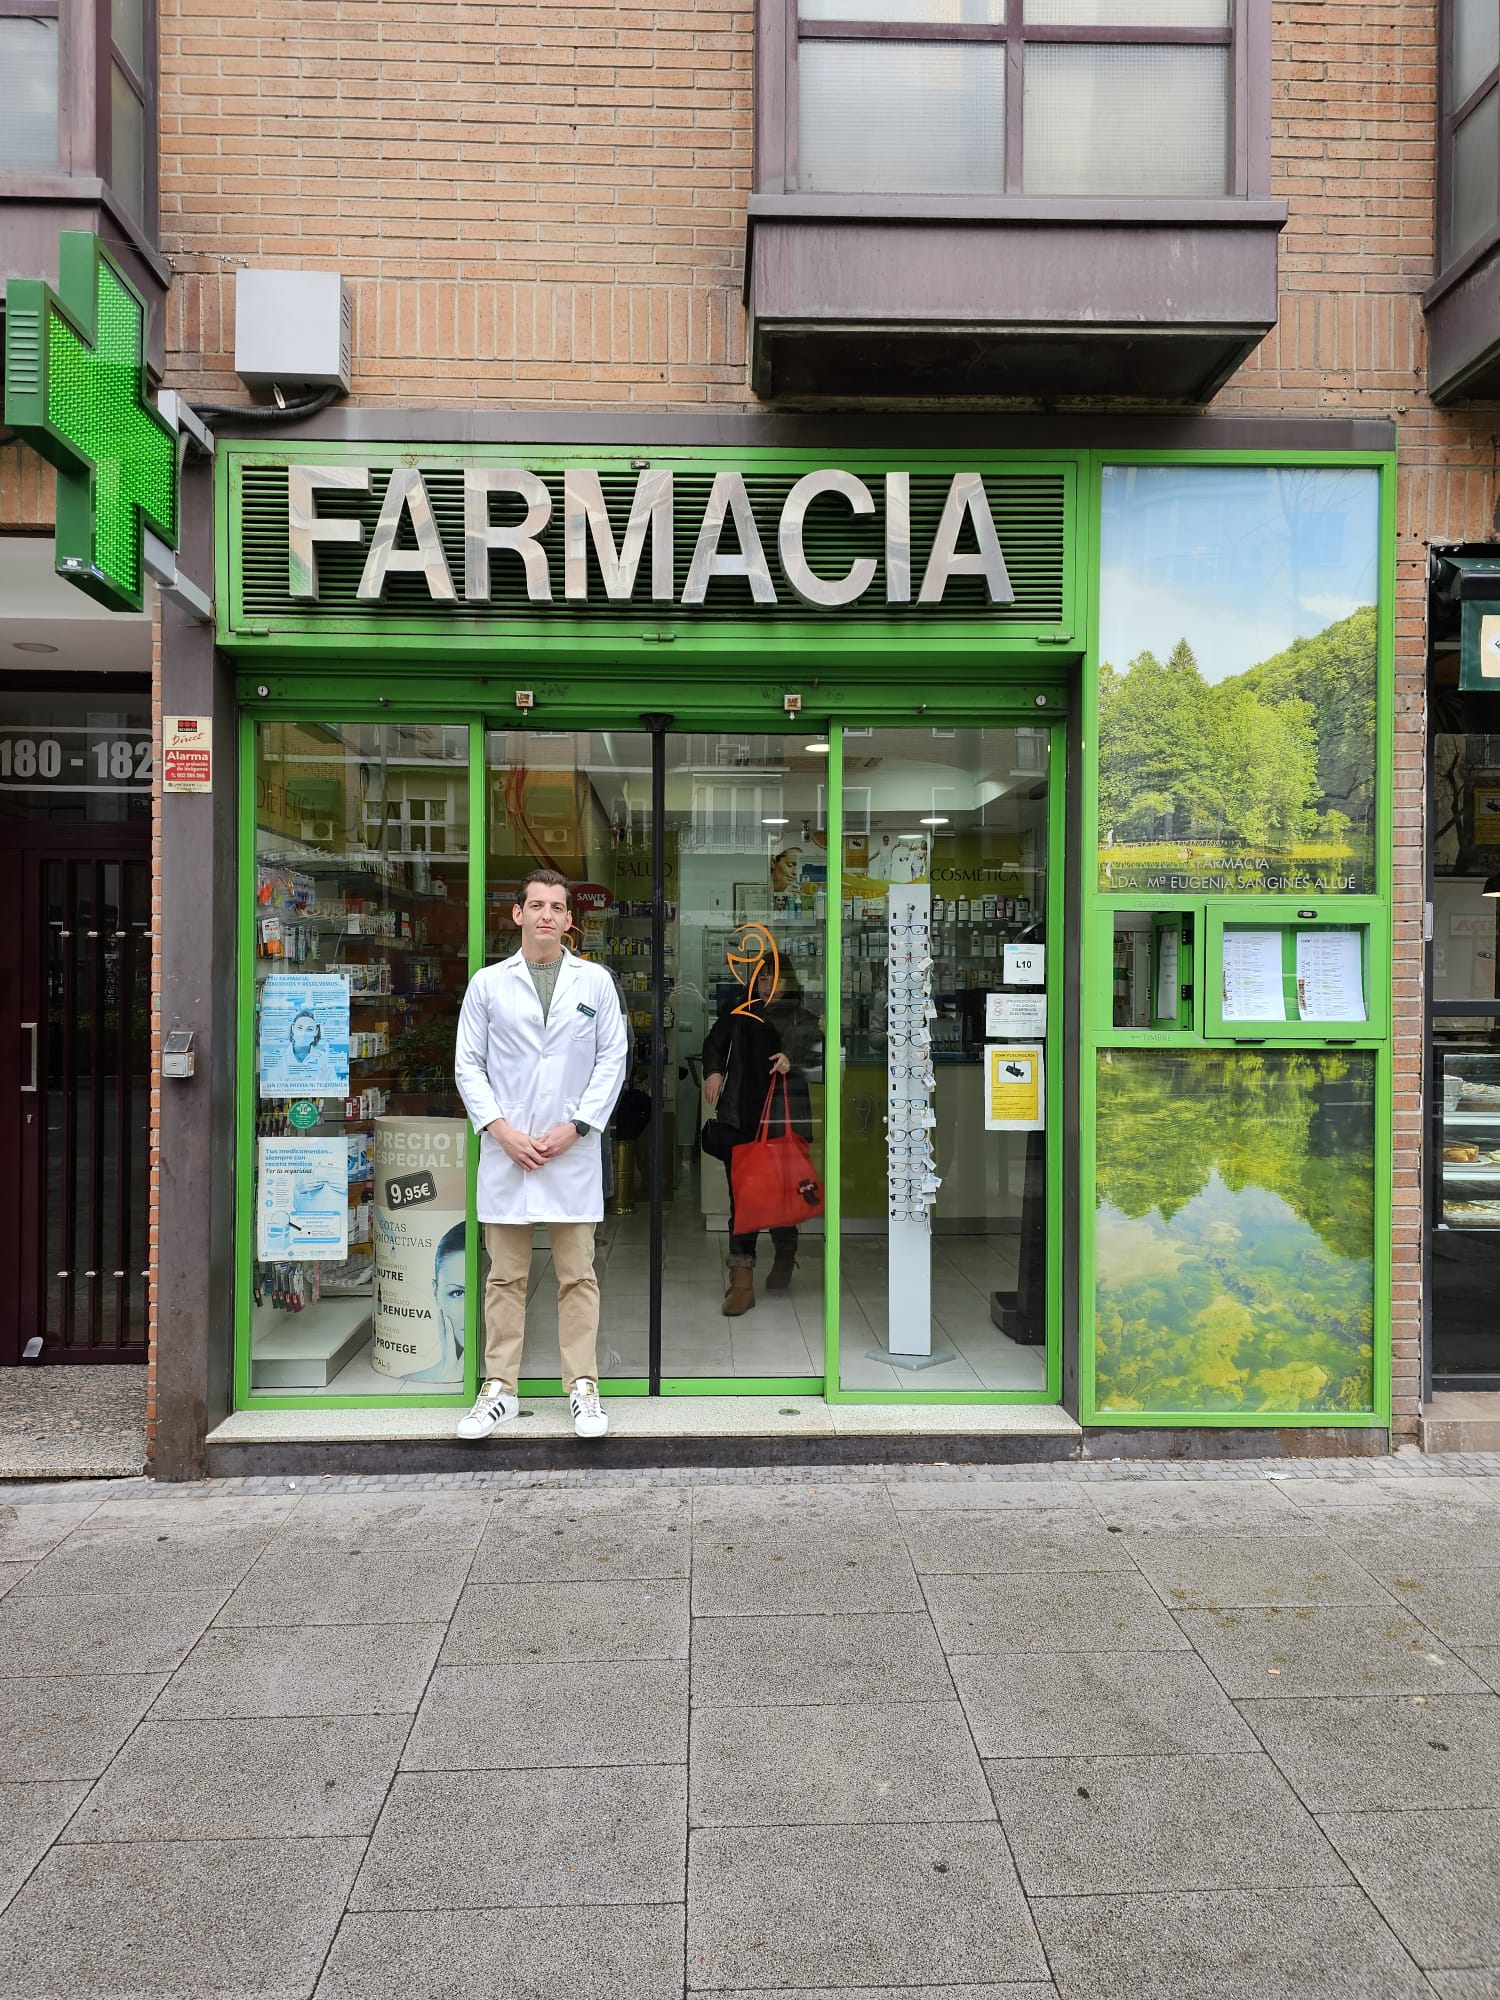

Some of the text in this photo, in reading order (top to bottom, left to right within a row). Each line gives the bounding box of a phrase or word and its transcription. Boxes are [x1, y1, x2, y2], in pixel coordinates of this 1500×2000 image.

[288, 465, 1015, 611] FARMACIA
[0, 739, 61, 778] 180
[92, 741, 153, 779] 182
[166, 751, 209, 761] Alarma
[1197, 857, 1270, 870] FARMACIA
[930, 864, 1020, 882] COSMÉTICA
[1110, 876, 1142, 889] LDA.
[1171, 876, 1234, 889] EUGENIA
[1237, 873, 1310, 890] SANGINÉS
[1314, 873, 1356, 889] ALLUÉ
[1016, 960, 1032, 969] L10
[1143, 1033, 1173, 1042] TIMBRE
[376, 1130, 451, 1151] PRECIO
[376, 1150, 452, 1168] ESPECIAL
[390, 1182, 431, 1204] 9,95€
[380, 1220, 407, 1233] GOTAS
[375, 1269, 404, 1282] NUTRE
[383, 1304, 432, 1319] RENUEVA
[376, 1336, 417, 1355] PROTEGE
